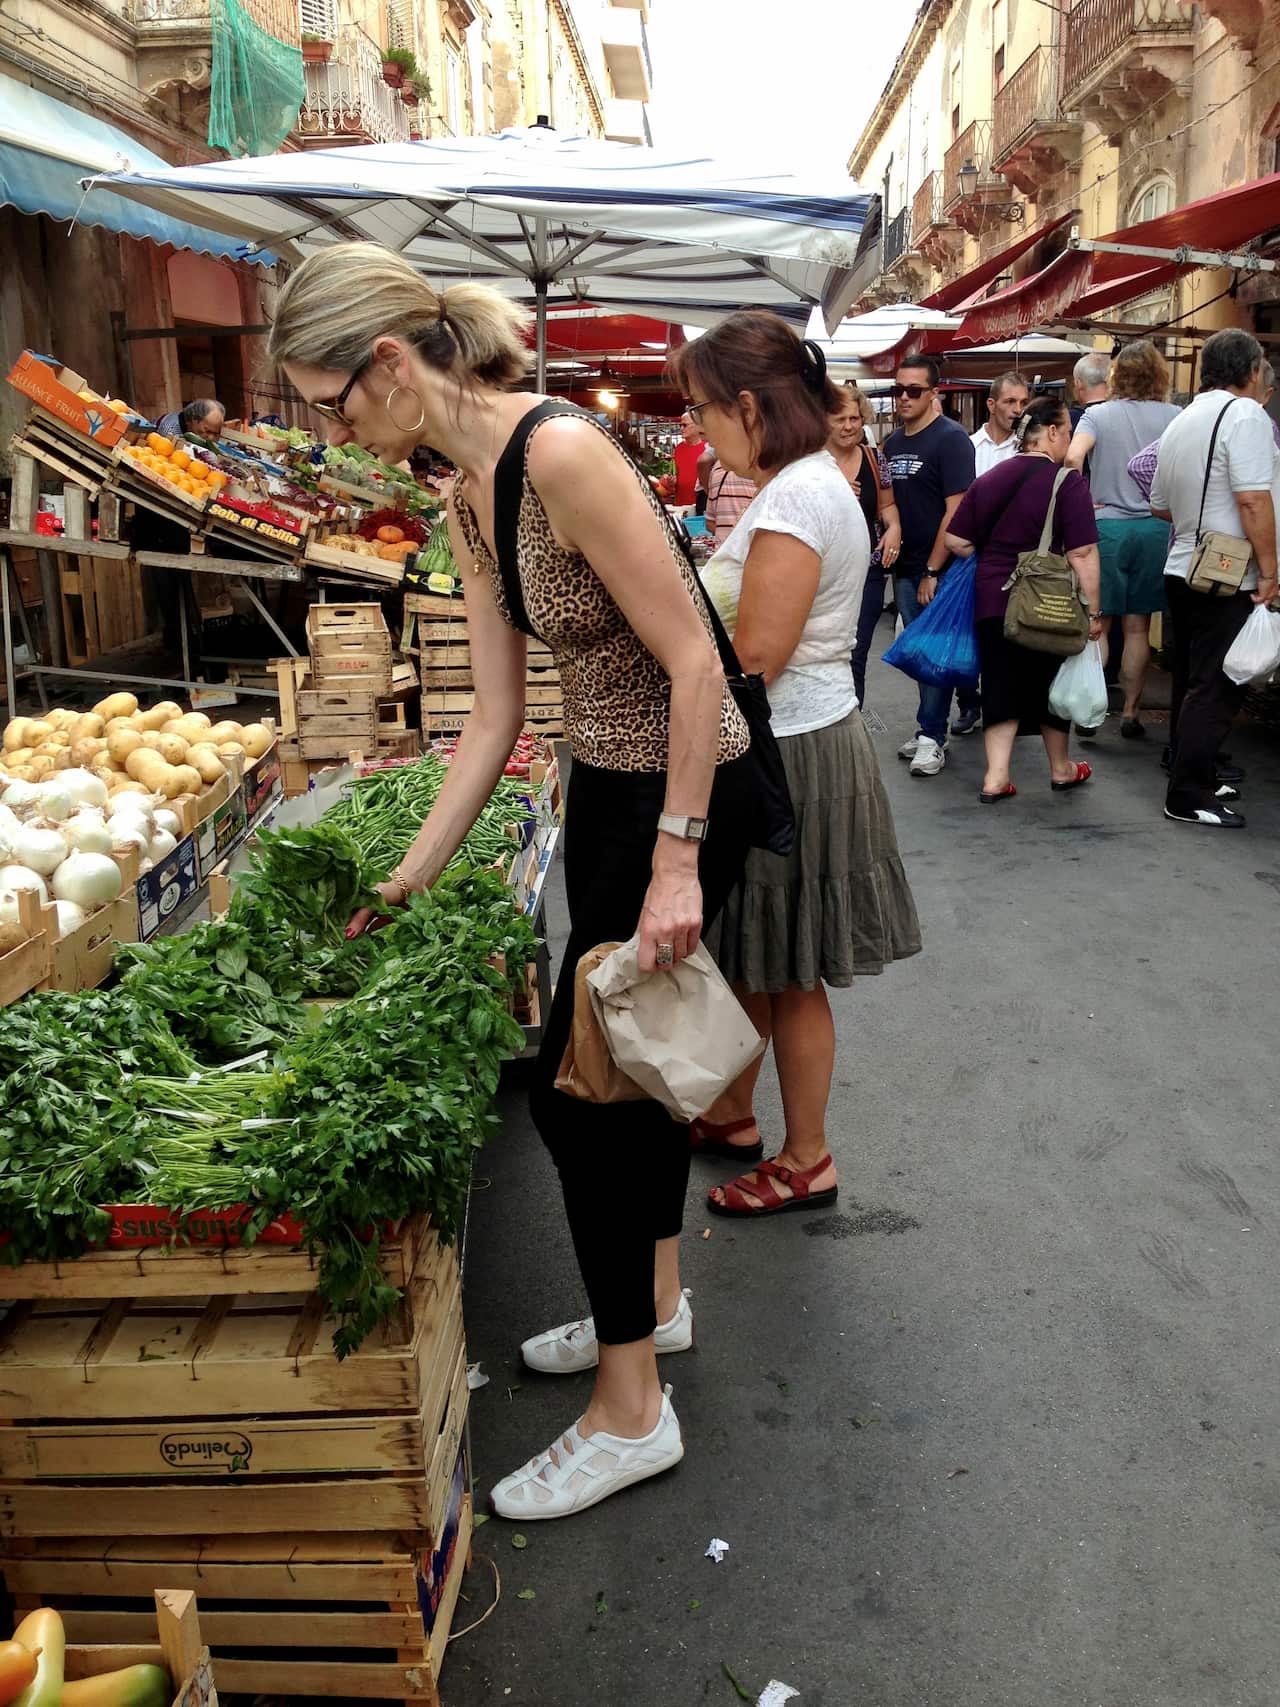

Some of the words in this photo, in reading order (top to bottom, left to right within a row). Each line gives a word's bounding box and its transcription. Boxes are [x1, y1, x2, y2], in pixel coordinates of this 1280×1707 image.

[13, 373, 54, 403] ALLIANCE
[55, 400, 82, 422] FRUIT
[240, 517, 258, 530] di
[256, 523, 301, 546] Sicilia
[164, 1441, 249, 1461] Melinda
